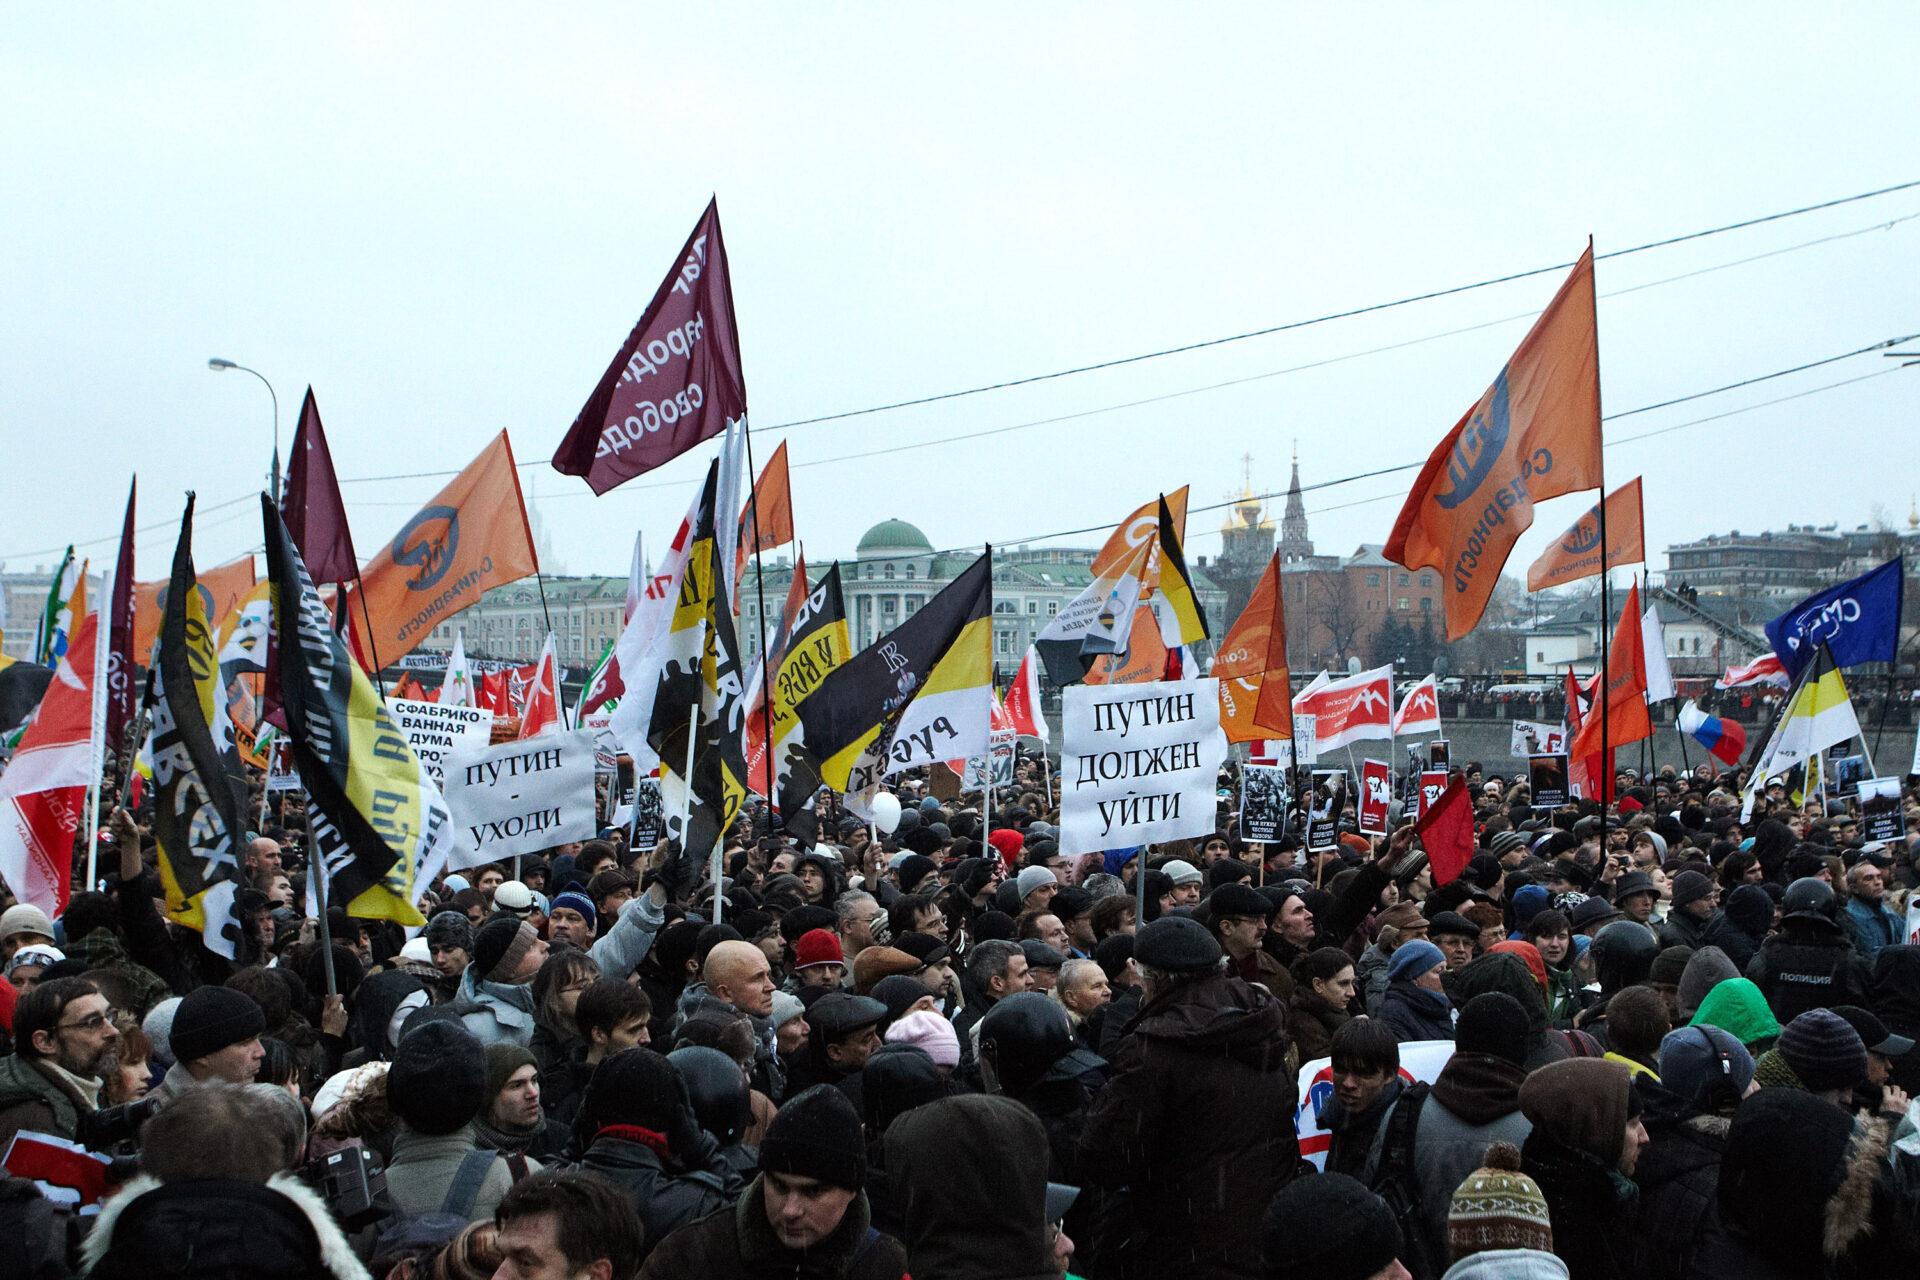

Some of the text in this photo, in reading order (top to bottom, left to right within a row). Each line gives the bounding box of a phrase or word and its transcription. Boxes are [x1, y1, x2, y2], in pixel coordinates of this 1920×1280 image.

[402, 717, 466, 734] ВАННАЯ
[1094, 693, 1196, 738] ПУТИН
[409, 734, 453, 747] ДУМА
[465, 748, 563, 787] ПУТИН
[1076, 742, 1201, 791] ДОЛЖЕН
[470, 806, 562, 851] УХОДИ
[1098, 791, 1181, 837] УЙТИ
[1780, 972, 1832, 985] ПОЛИЦИЯ
